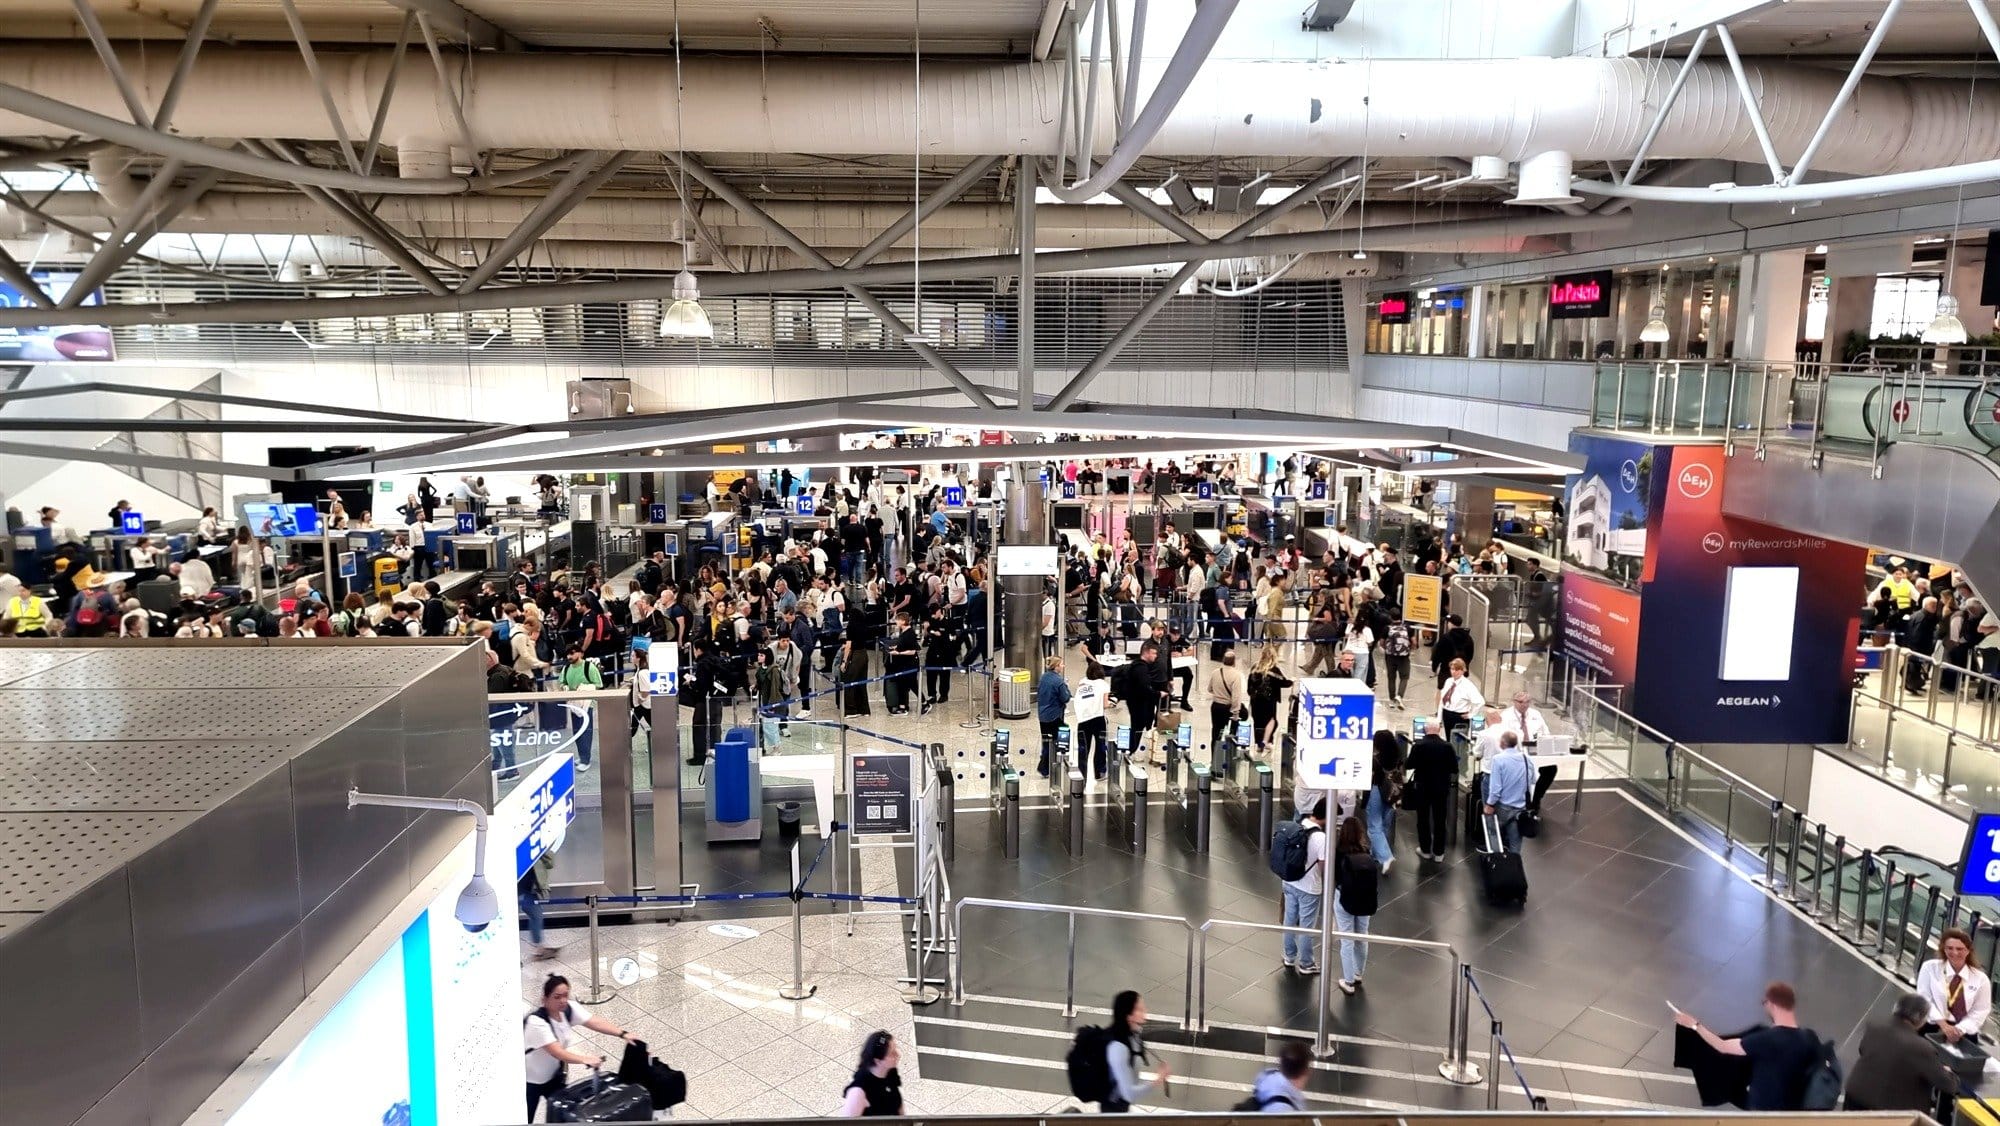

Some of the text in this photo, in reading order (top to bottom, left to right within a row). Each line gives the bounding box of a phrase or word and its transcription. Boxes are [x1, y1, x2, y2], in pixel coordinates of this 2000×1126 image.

[1551, 283, 1564, 304] La
[1793, 351, 1818, 381] LCI
[1623, 468, 1635, 484] ΔΕΗ
[1681, 472, 1708, 489] ΔΕΗ
[950, 491, 960, 502] 11
[1064, 486, 1074, 496] 10
[1202, 486, 1208, 496] 9
[1316, 486, 1322, 496] 8
[799, 500, 812, 511] 12
[652, 509, 664, 520] 13
[459, 518, 473, 530] 14
[1705, 537, 1721, 548] ΔΕΗ
[1729, 538, 1827, 551] myRewardsMiles
[1716, 697, 1770, 706] AEGEAN
[1312, 715, 1369, 739] B 1-31
[490, 729, 562, 746] st Lane
